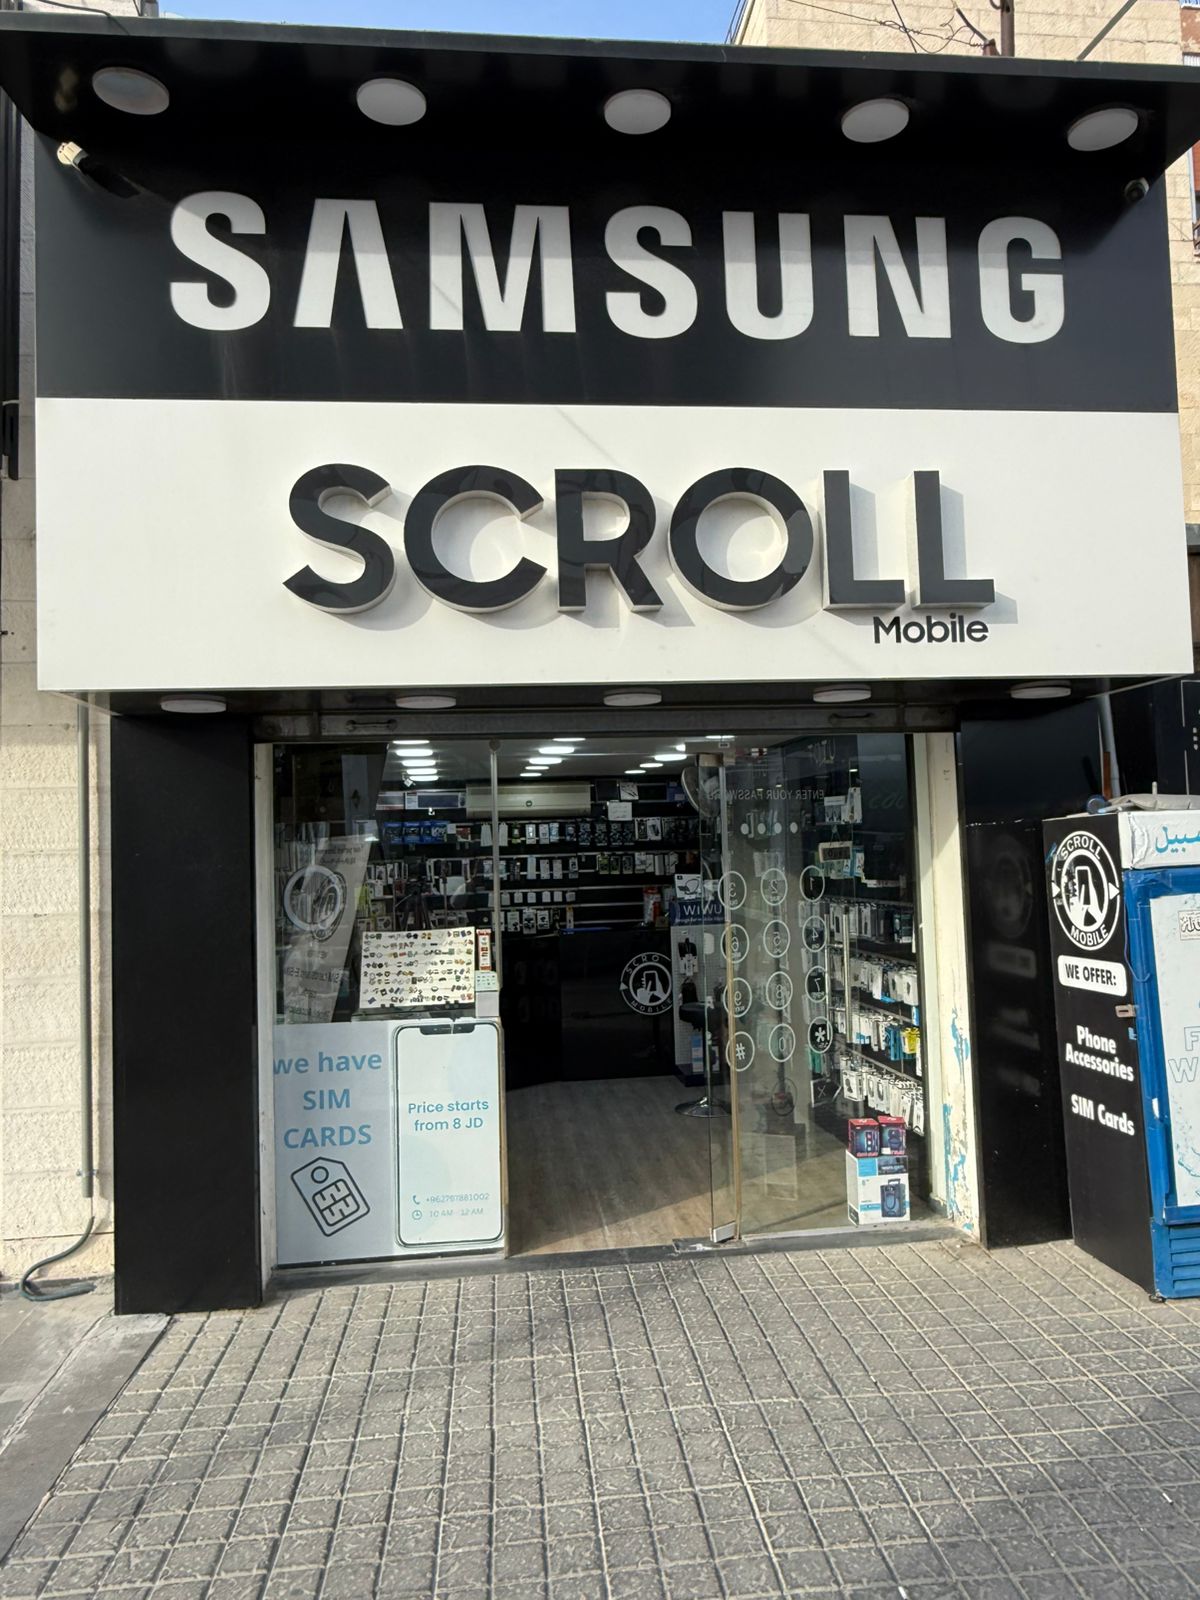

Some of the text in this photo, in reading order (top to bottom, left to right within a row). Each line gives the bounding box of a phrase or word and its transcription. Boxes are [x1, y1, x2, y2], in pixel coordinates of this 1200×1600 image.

[170, 191, 1065, 344] SAMSUNG
[283, 462, 995, 613] SCROLL
[872, 613, 989, 644] Mobile
[1060, 834, 1103, 861] SCROLL
[1070, 923, 1109, 946] MOBILE
[625, 954, 660, 975] SCRO
[1065, 963, 1117, 986] WE OFFER:
[1076, 1025, 1117, 1054] Phone
[273, 1051, 382, 1075] we have
[1065, 1043, 1135, 1082] Accessories
[303, 1088, 351, 1110] SIM
[408, 1099, 489, 1114] Price starts
[414, 1116, 484, 1131] from 8 JD
[1070, 1093, 1135, 1137] SIM Cards
[283, 1124, 372, 1149] CARDS
